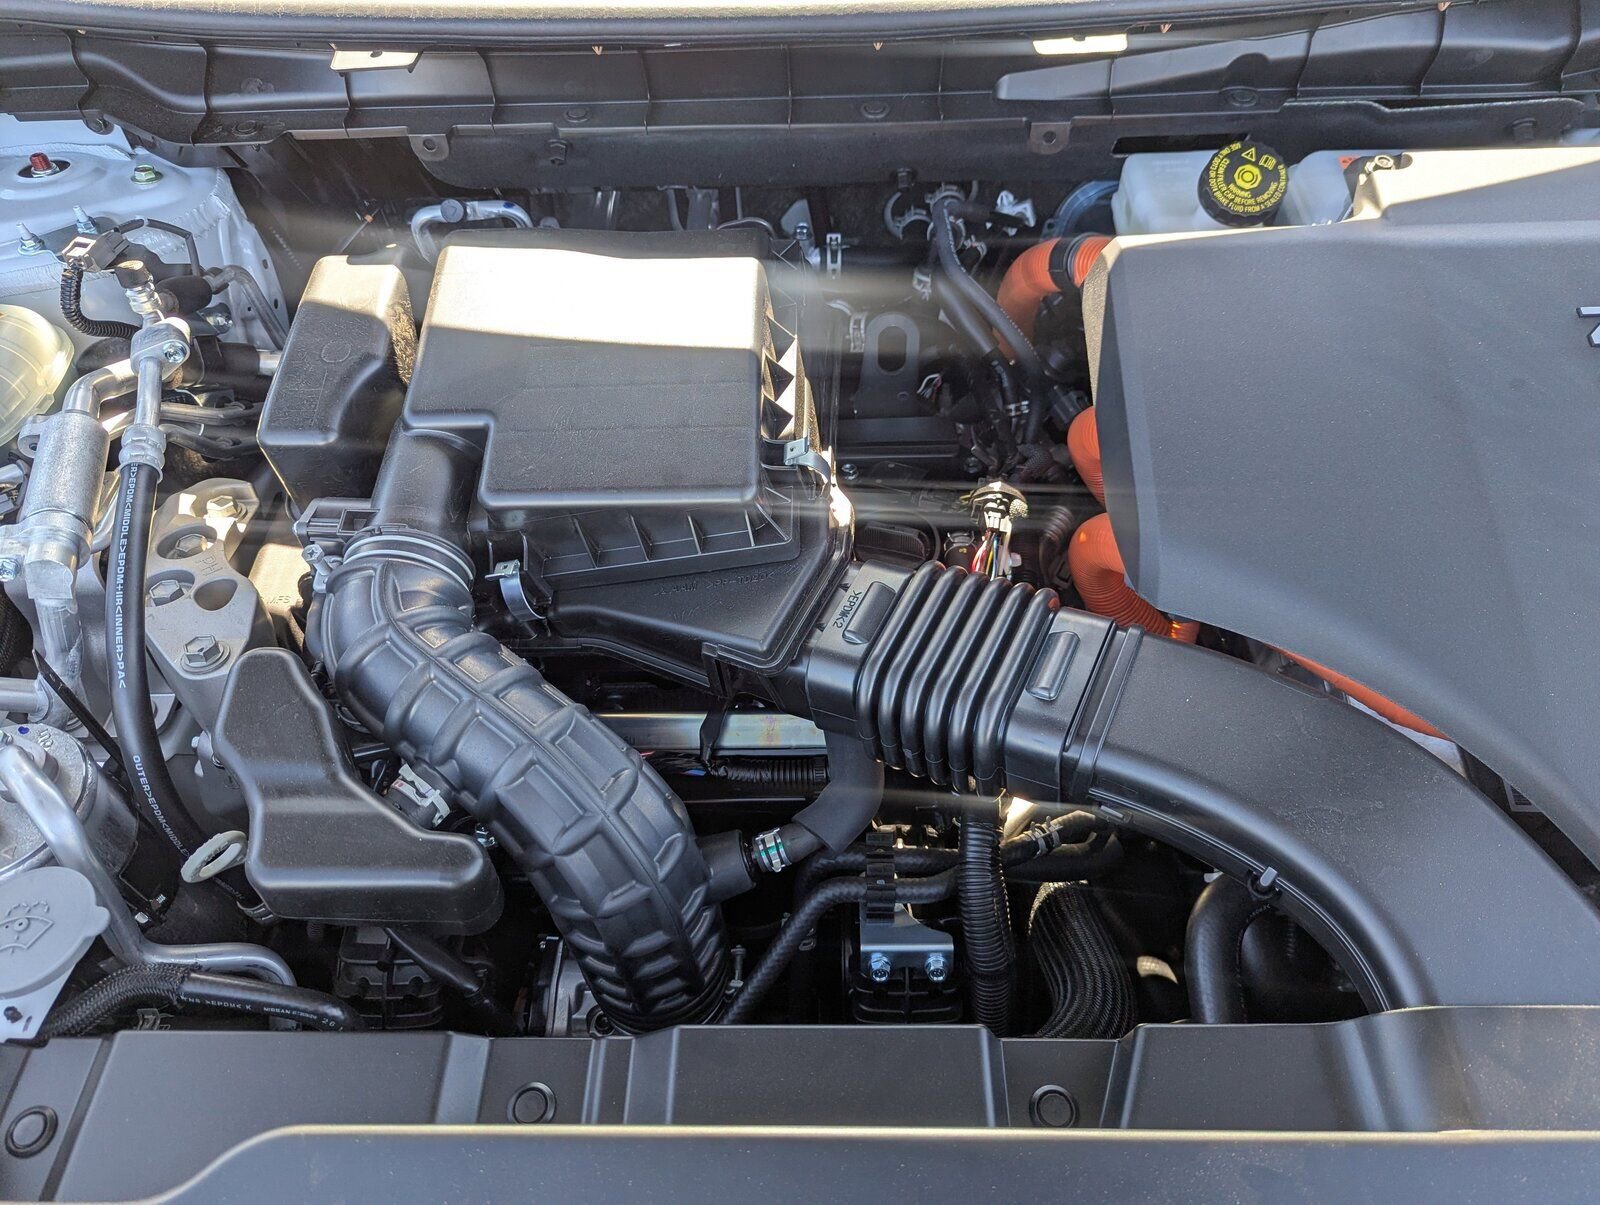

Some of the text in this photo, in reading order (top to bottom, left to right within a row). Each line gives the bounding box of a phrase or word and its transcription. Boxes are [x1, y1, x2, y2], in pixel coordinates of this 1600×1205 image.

[1213, 190, 1229, 206] BRAKE
[1227, 201, 1244, 212] FLUID
[1265, 191, 1281, 207] SEALED
[1233, 196, 1256, 205] BEFORE
